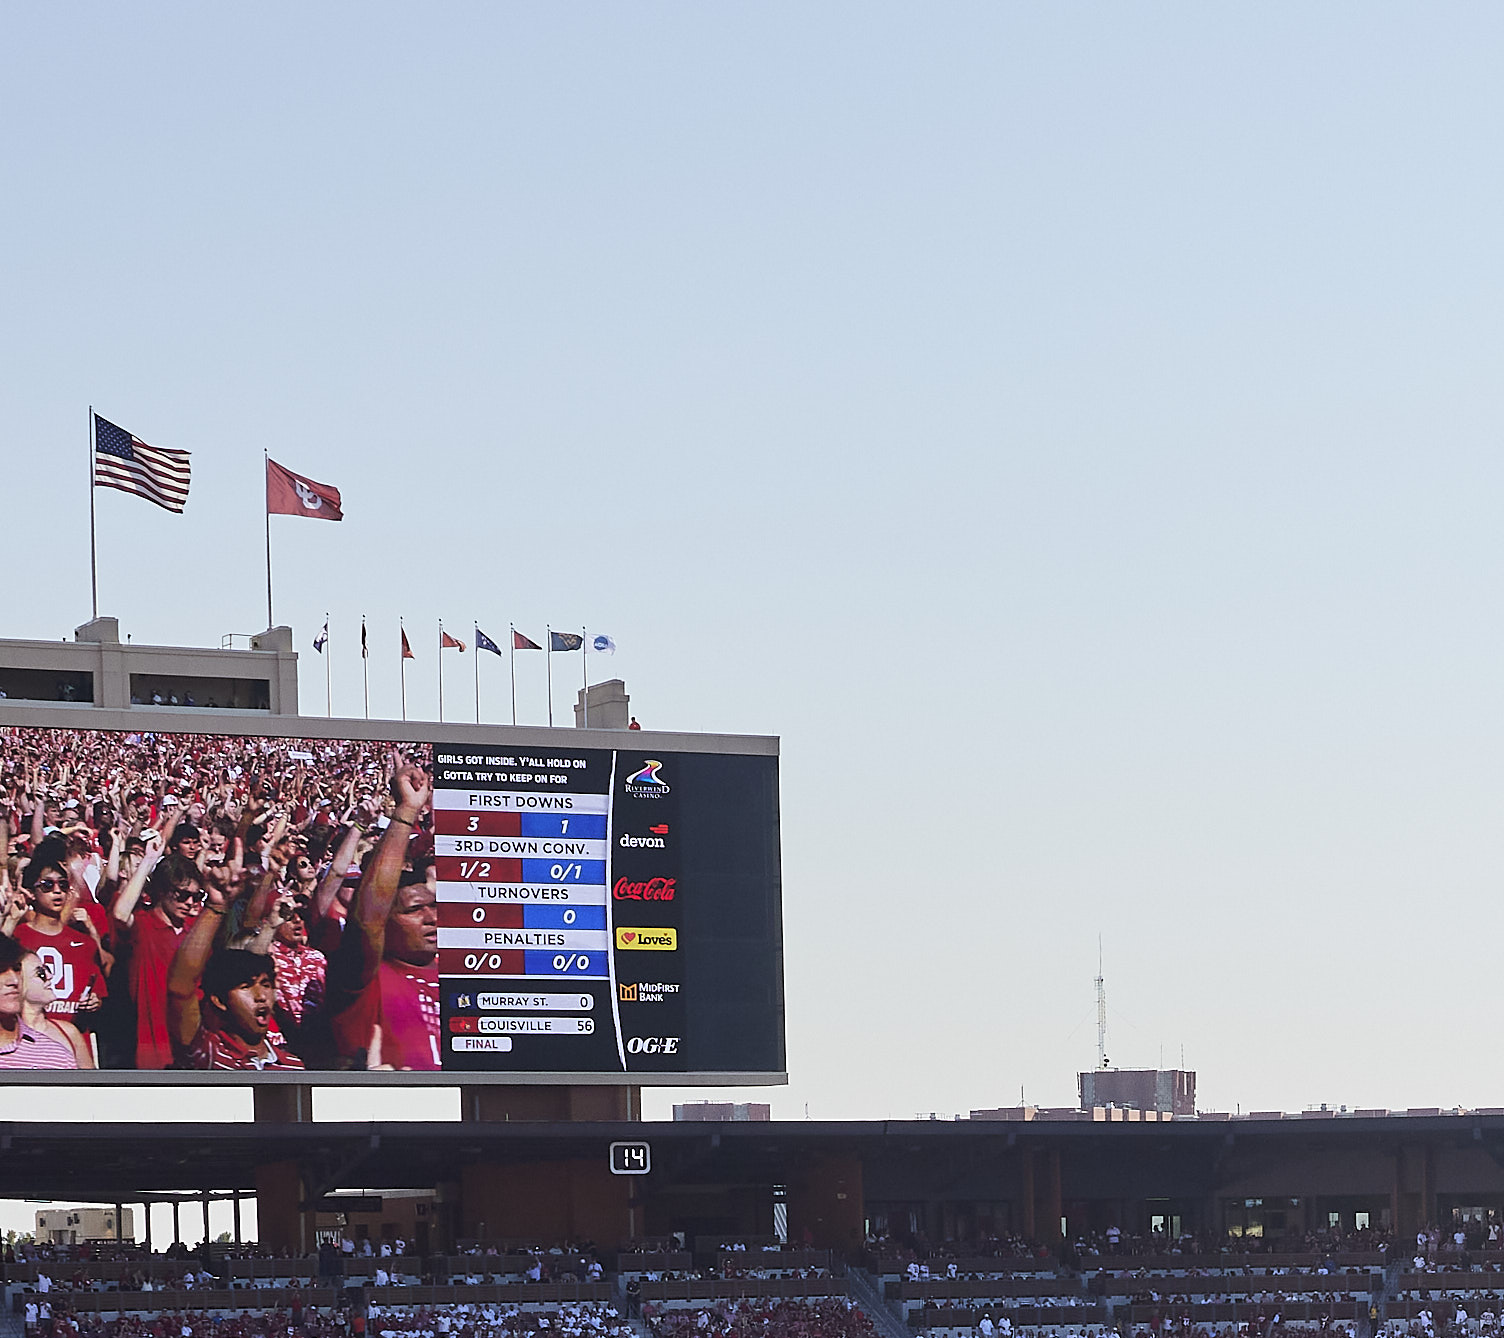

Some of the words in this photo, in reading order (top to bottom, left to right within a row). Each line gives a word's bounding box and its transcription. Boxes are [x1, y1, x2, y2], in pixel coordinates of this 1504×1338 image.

[438, 755, 464, 764] GIRLS
[466, 756, 483, 765] GOT
[485, 756, 517, 767] INSIDE.
[520, 756, 544, 767] Y'ALL
[547, 758, 570, 768] HOLD
[572, 759, 586, 768] ON
[444, 771, 473, 781] GOTTA
[475, 772, 493, 782] TRY
[496, 773, 507, 782] TO
[510, 773, 532, 783] KEEP
[535, 774, 548, 783] ON
[551, 774, 567, 784] FOR
[469, 795, 511, 807] FIRST
[516, 796, 573, 808] DOWNS
[467, 817, 478, 831] 3
[560, 820, 569, 833] 1
[620, 833, 665, 848] devon
[455, 841, 483, 852] 3RD
[490, 841, 537, 853] DOWN
[543, 842, 589, 854] CONV.
[460, 862, 490, 877] 1/2
[551, 864, 582, 880] 0/1
[478, 887, 569, 899] TURNOVERS
[472, 908, 485, 922] 0
[564, 910, 575, 924] 0
[484, 933, 565, 945] PENALTIES
[465, 955, 501, 969] 0/0
[553, 955, 589, 970] 0/0
[483, 996, 529, 1007] MURRAY
[533, 996, 548, 1006] ST.
[580, 997, 588, 1008] 0
[481, 1020, 551, 1031] LOUISVILLE
[577, 1020, 592, 1032] 56
[465, 1039, 498, 1049] FINAL
[625, 1149, 643, 1167] 14
